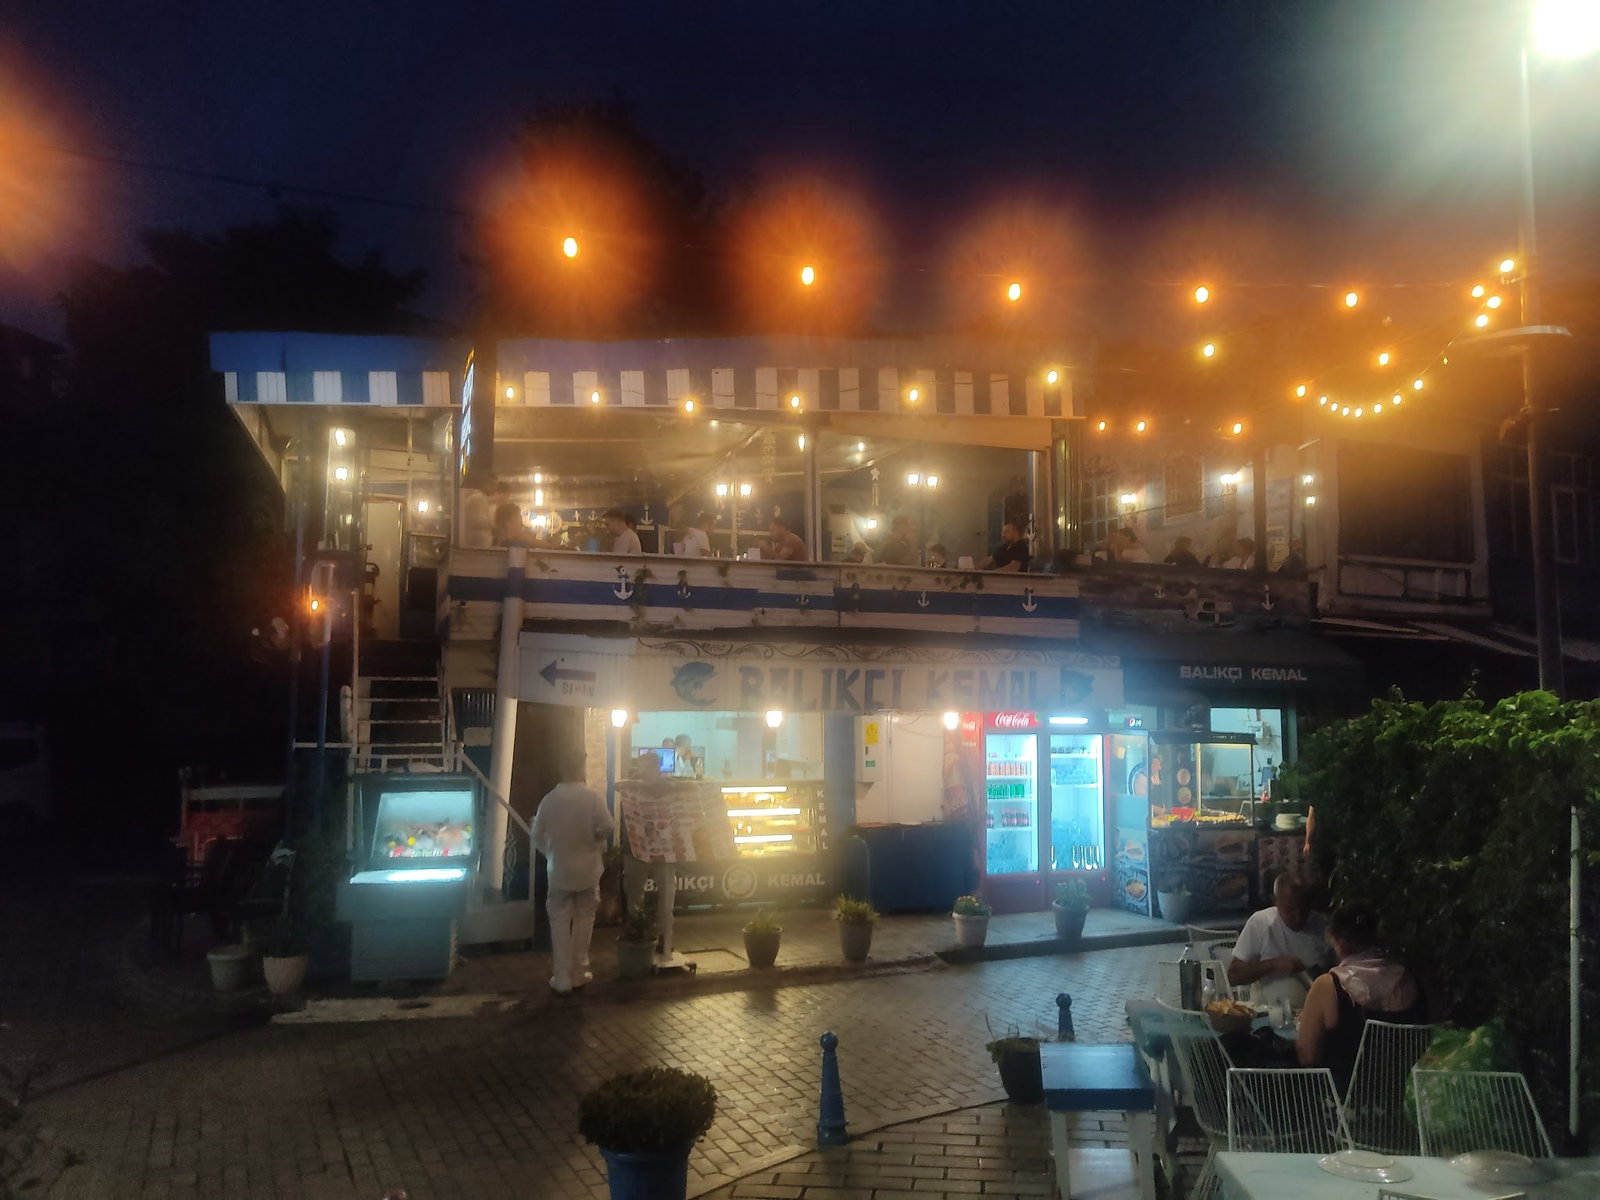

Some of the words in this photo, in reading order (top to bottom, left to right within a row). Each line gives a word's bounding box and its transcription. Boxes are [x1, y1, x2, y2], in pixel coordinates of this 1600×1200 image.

[1180, 666, 1242, 683] BALIKÇI
[1252, 668, 1307, 681] KEMAL
[927, 670, 1044, 709] KEMAL
[816, 790, 828, 850] KEMAL
[768, 872, 825, 888] KEMAL
